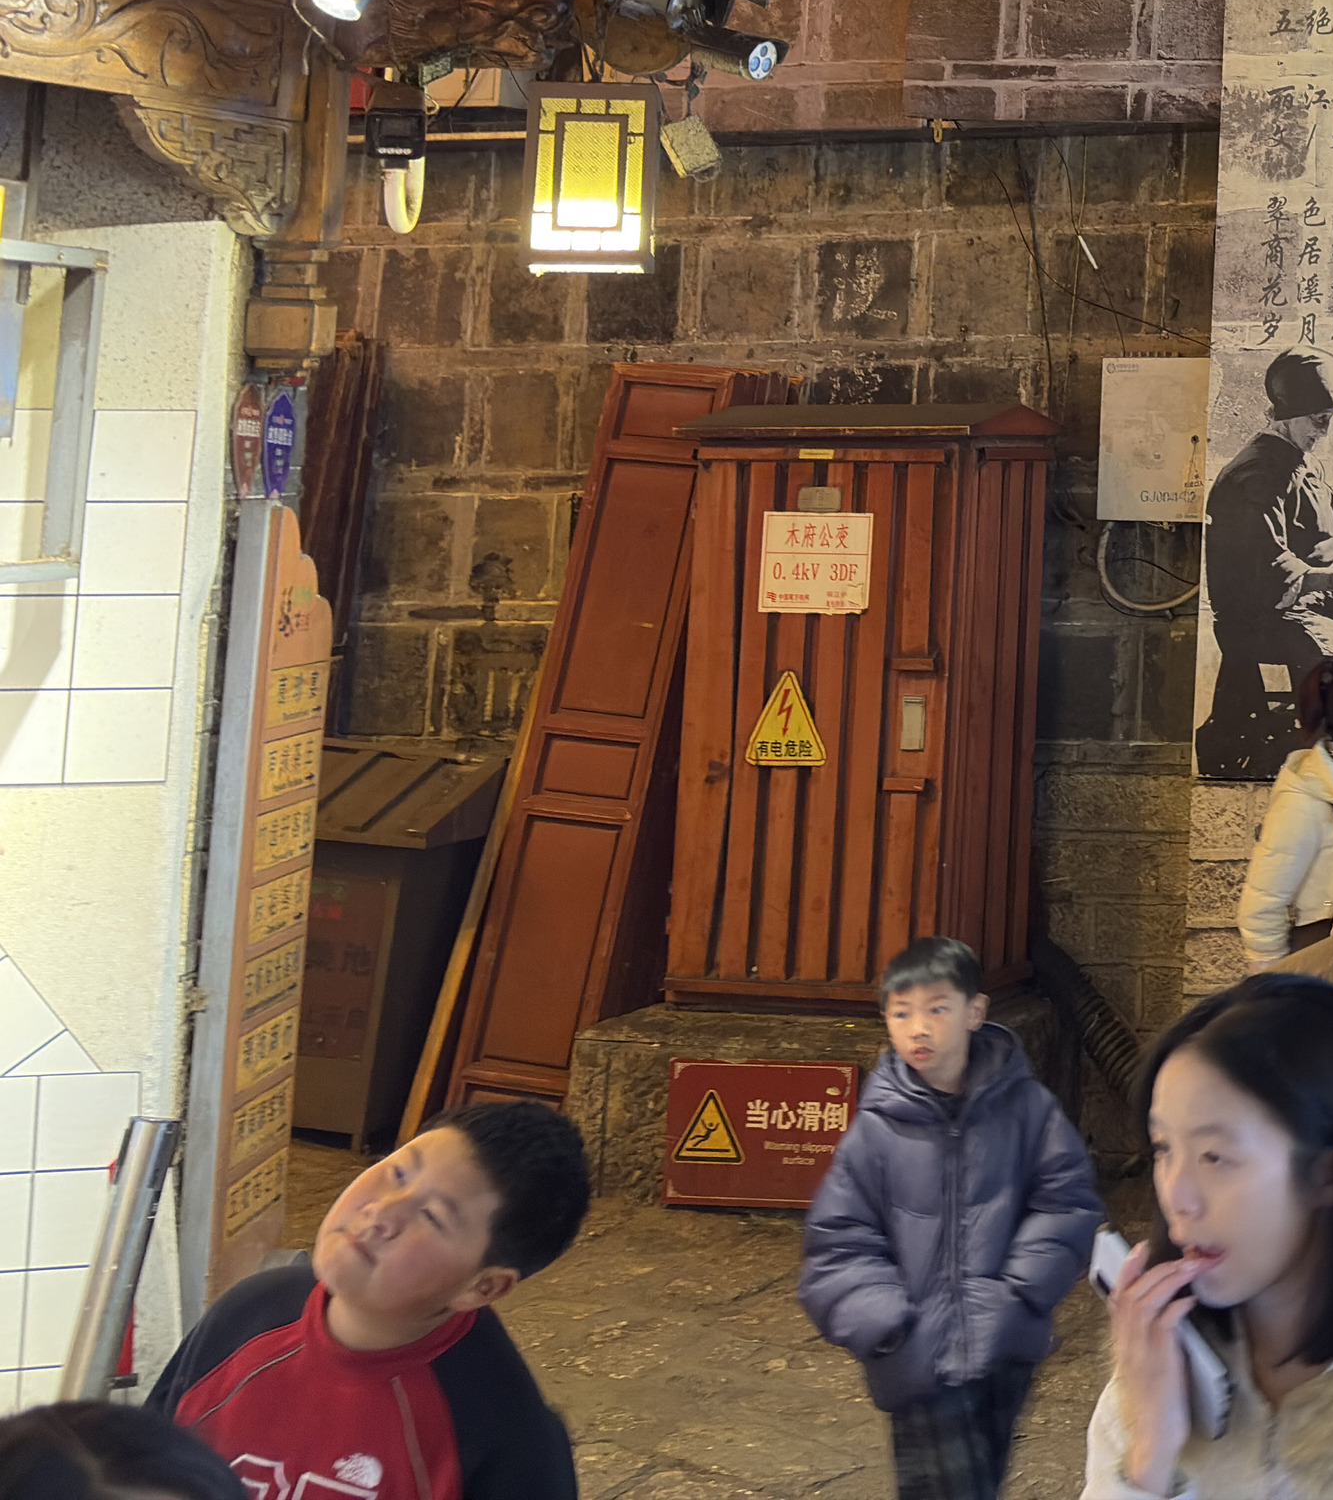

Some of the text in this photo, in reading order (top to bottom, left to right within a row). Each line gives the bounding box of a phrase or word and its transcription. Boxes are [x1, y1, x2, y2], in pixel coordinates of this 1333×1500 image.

[1269, 6, 1333, 36] 五绝
[785, 522, 849, 548] 木府公变
[773, 562, 858, 581] 0.4kV 3DF
[756, 740, 813, 757] 有电危险
[745, 1099, 849, 1132] 当心滑倒
[764, 1140, 800, 1153] Warning
